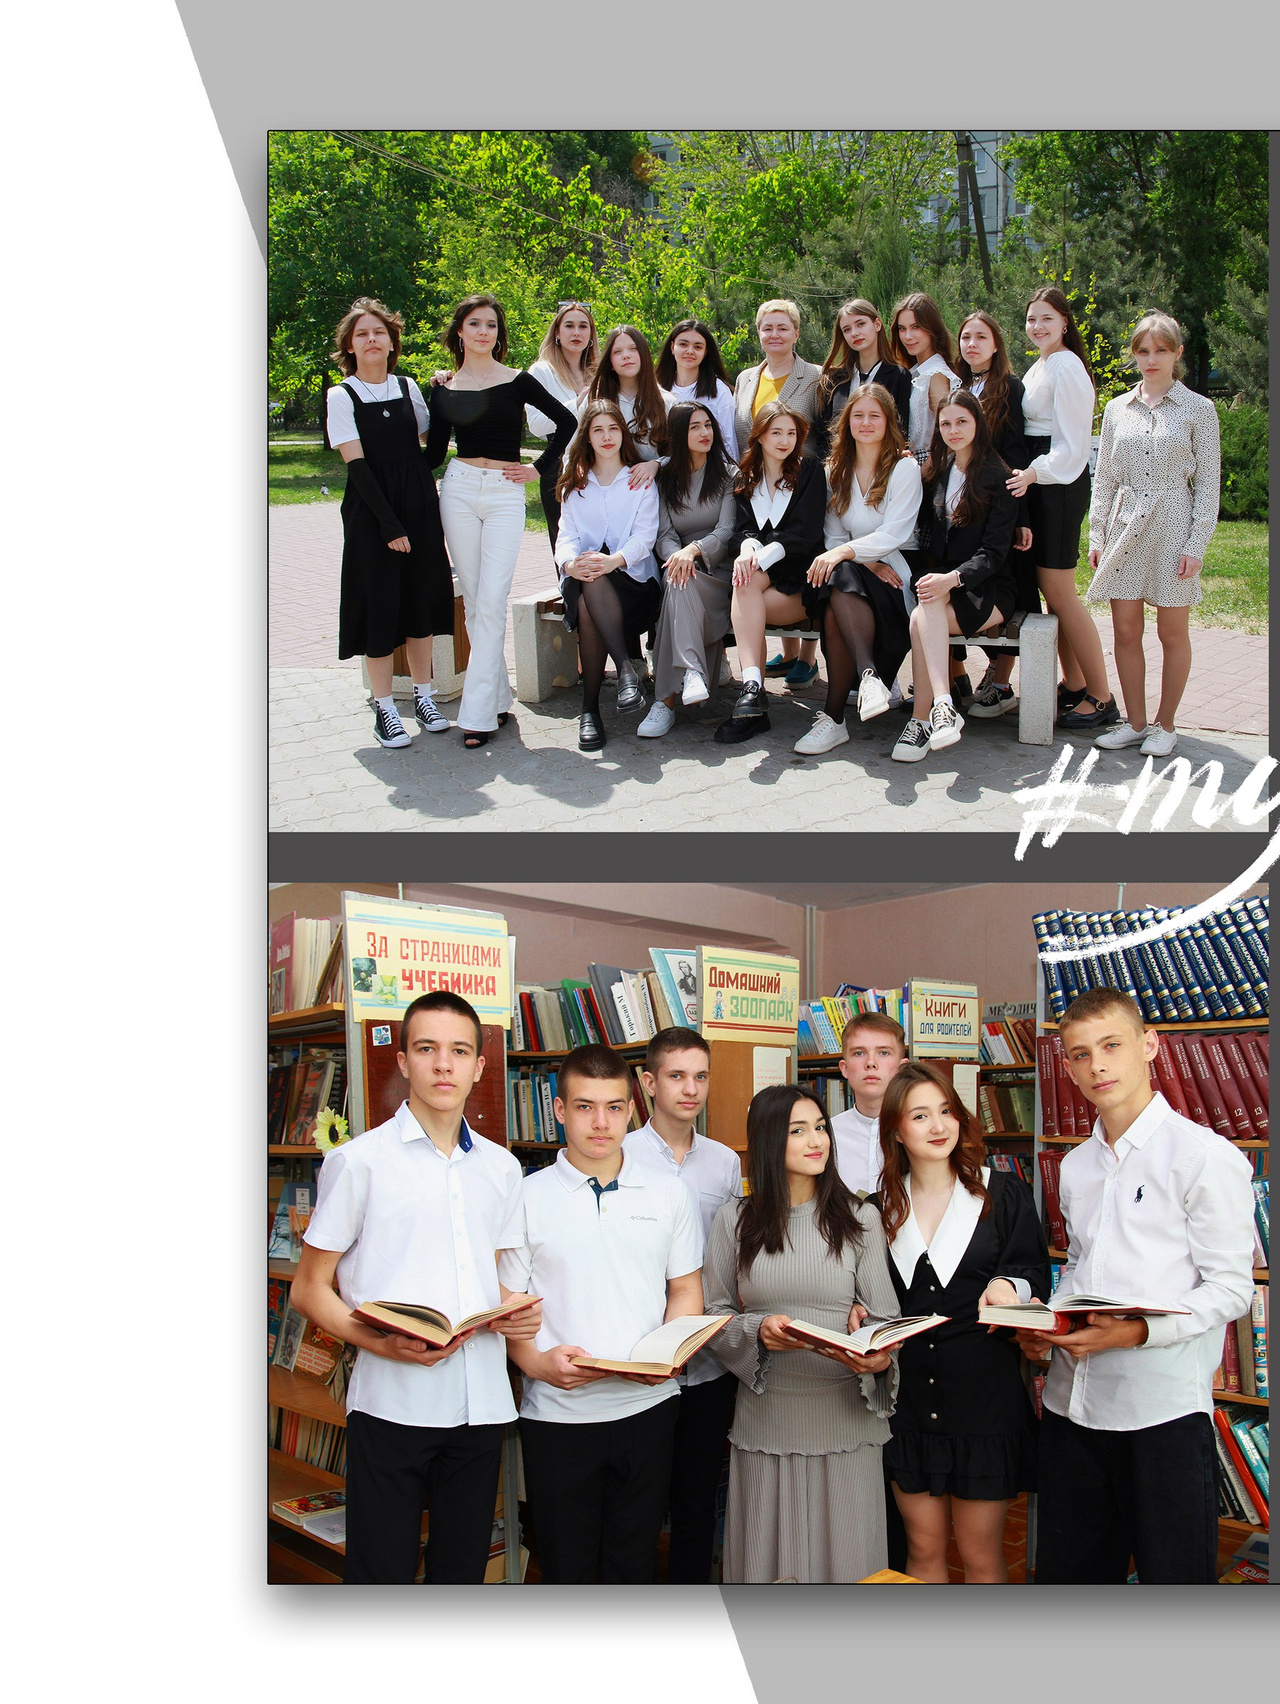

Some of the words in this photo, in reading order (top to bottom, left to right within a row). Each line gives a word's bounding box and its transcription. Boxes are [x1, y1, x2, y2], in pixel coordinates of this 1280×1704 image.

[367, 932, 388, 958] ЗА
[400, 938, 501, 968] СТРАНИЦАМИ
[730, 996, 793, 1022] ЗООПАРК
[619, 999, 636, 1037] Горький
[920, 1023, 934, 1034] ДЛЯ
[937, 1022, 971, 1036] РОДИТЕЛЕЙ
[1214, 1107, 1221, 1115] 11
[1234, 1108, 1242, 1116] 12
[1254, 1107, 1262, 1115] 13
[544, 1102, 555, 1136] Некрасов
[1051, 1220, 1060, 1228] 20
[1229, 1376, 1235, 1384] 2
